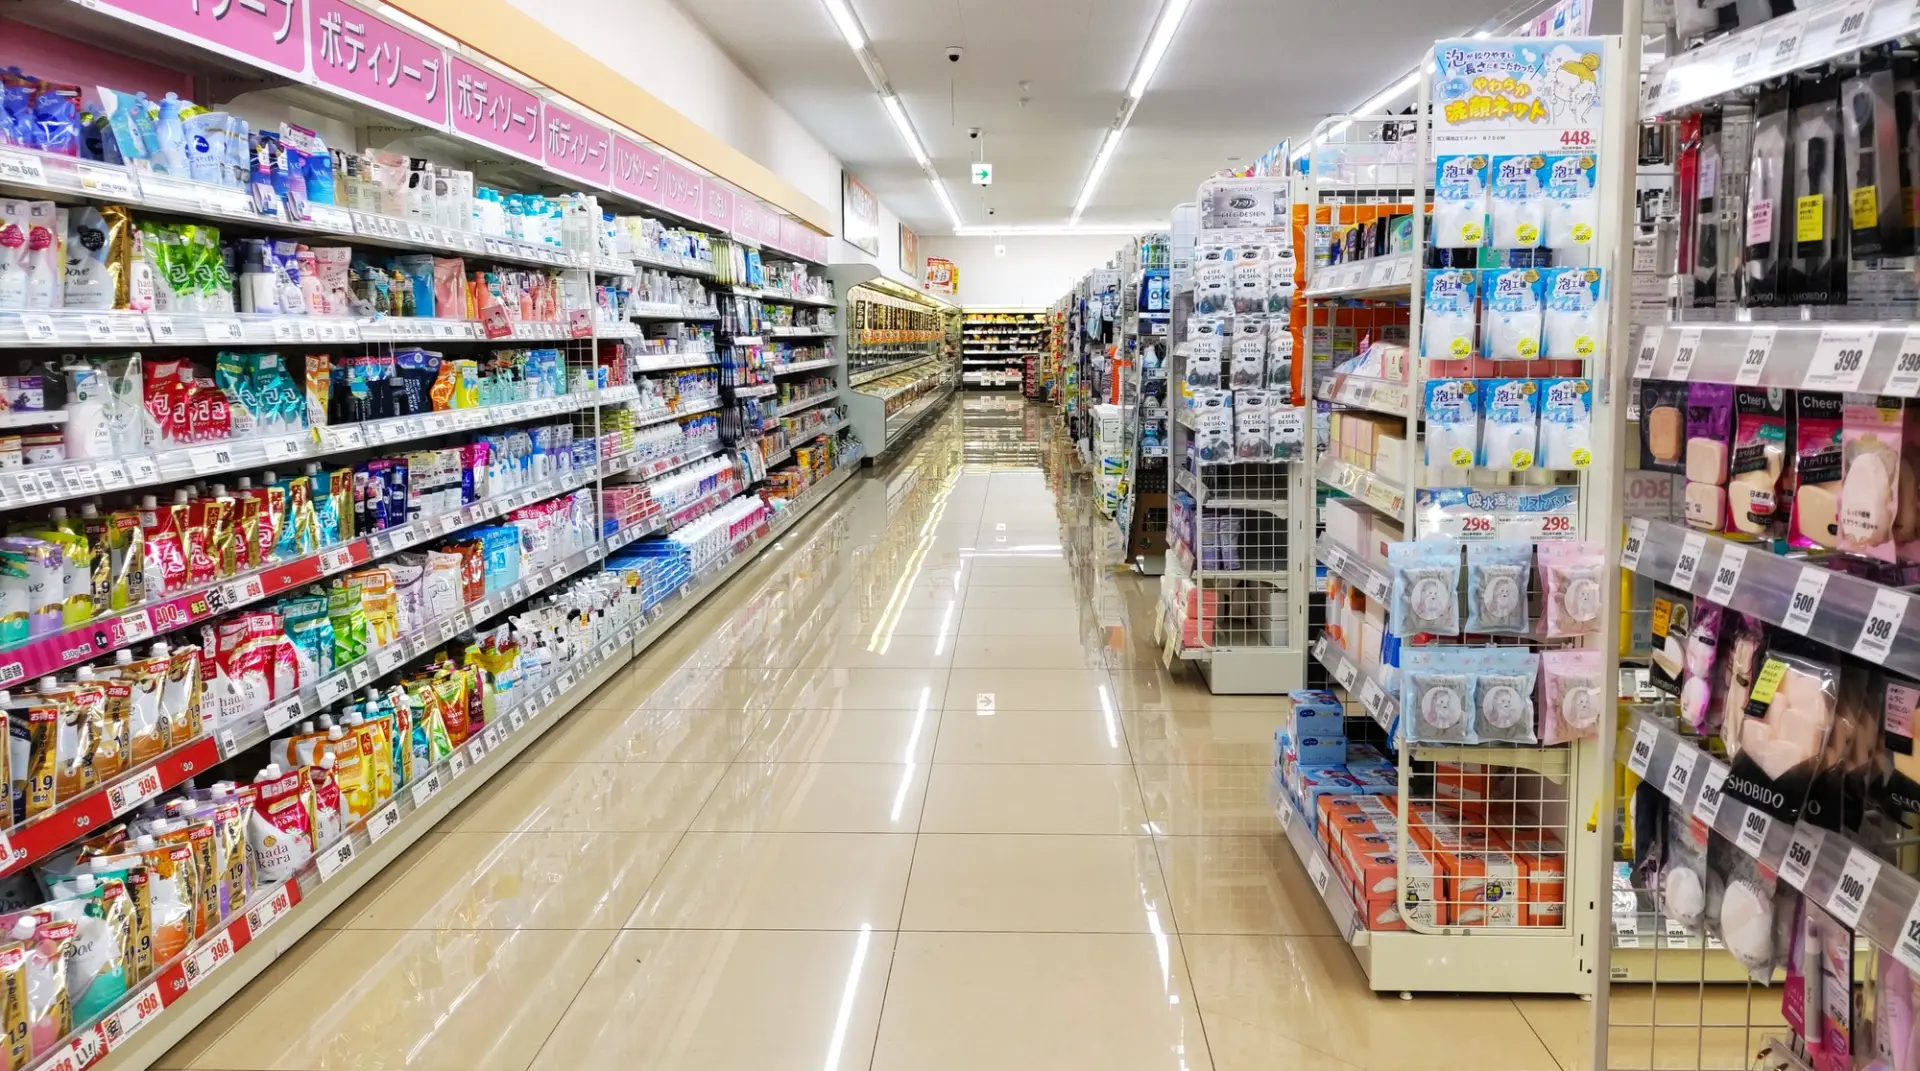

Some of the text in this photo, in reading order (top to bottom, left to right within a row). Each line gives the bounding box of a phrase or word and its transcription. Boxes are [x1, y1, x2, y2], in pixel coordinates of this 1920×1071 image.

[319, 11, 439, 102] ボディソープ
[1445, 49, 1515, 67] 泡が絞りやすい
[1464, 62, 1535, 75] 長さにもこだわった
[1472, 76, 1532, 98] やわらか
[457, 74, 538, 143] ボディソープ
[1444, 95, 1547, 124] 洗顔ネット
[548, 118, 608, 172] ボディソープ
[615, 147, 661, 193] ハンドソープ
[664, 171, 700, 209] ハンドソープ
[137, 279, 152, 288] had
[138, 286, 152, 295] kar
[856, 300, 865, 329] からあげ
[1640, 346, 1653, 362] 400
[1677, 347, 1693, 362] 220
[1745, 350, 1765, 365] 320
[1834, 350, 1863, 372] 398
[1898, 353, 1920, 372] 398
[1739, 392, 1767, 409] Cheery
[1802, 396, 1843, 413] Cheery
[286, 441, 298, 452] 478
[217, 450, 231, 463] 478
[1750, 490, 1771, 500] 日本製
[1626, 537, 1640, 553] 330
[1679, 555, 1695, 572] 350
[127, 572, 142, 584] 1.9
[1717, 568, 1735, 585] 380
[91, 581, 111, 594] 1.9
[247, 583, 261, 597] 698
[1793, 592, 1815, 613] 500
[1866, 617, 1892, 639] 398
[337, 680, 348, 692] 298
[190, 705, 200, 718] 1.9
[287, 703, 300, 720] 298
[115, 732, 130, 749] 1.9
[1635, 741, 1649, 759] 480
[1672, 765, 1688, 784] 278
[29, 775, 53, 793] 1.9
[138, 775, 157, 797] 398
[427, 777, 439, 793] 598
[1727, 774, 1785, 809] SHOBIDO
[1703, 785, 1719, 805] 380
[216, 807, 238, 821] お得な
[384, 808, 398, 826] 598
[1746, 813, 1766, 833] 900
[189, 825, 213, 839] お得な
[255, 843, 289, 859] hada
[338, 844, 352, 863] 598
[1789, 842, 1811, 866] 550
[257, 853, 291, 870] kara
[229, 863, 244, 880] 1.9
[1406, 876, 1431, 888] 2WAY
[1839, 874, 1865, 901] 1000
[204, 884, 217, 902] 1.9
[271, 893, 287, 915] 398
[1409, 907, 1433, 919] 2WAY
[1910, 919, 1920, 942] 12
[210, 937, 229, 962] 398
[136, 992, 158, 1020] 398
[9, 1021, 28, 1045] 1.9
